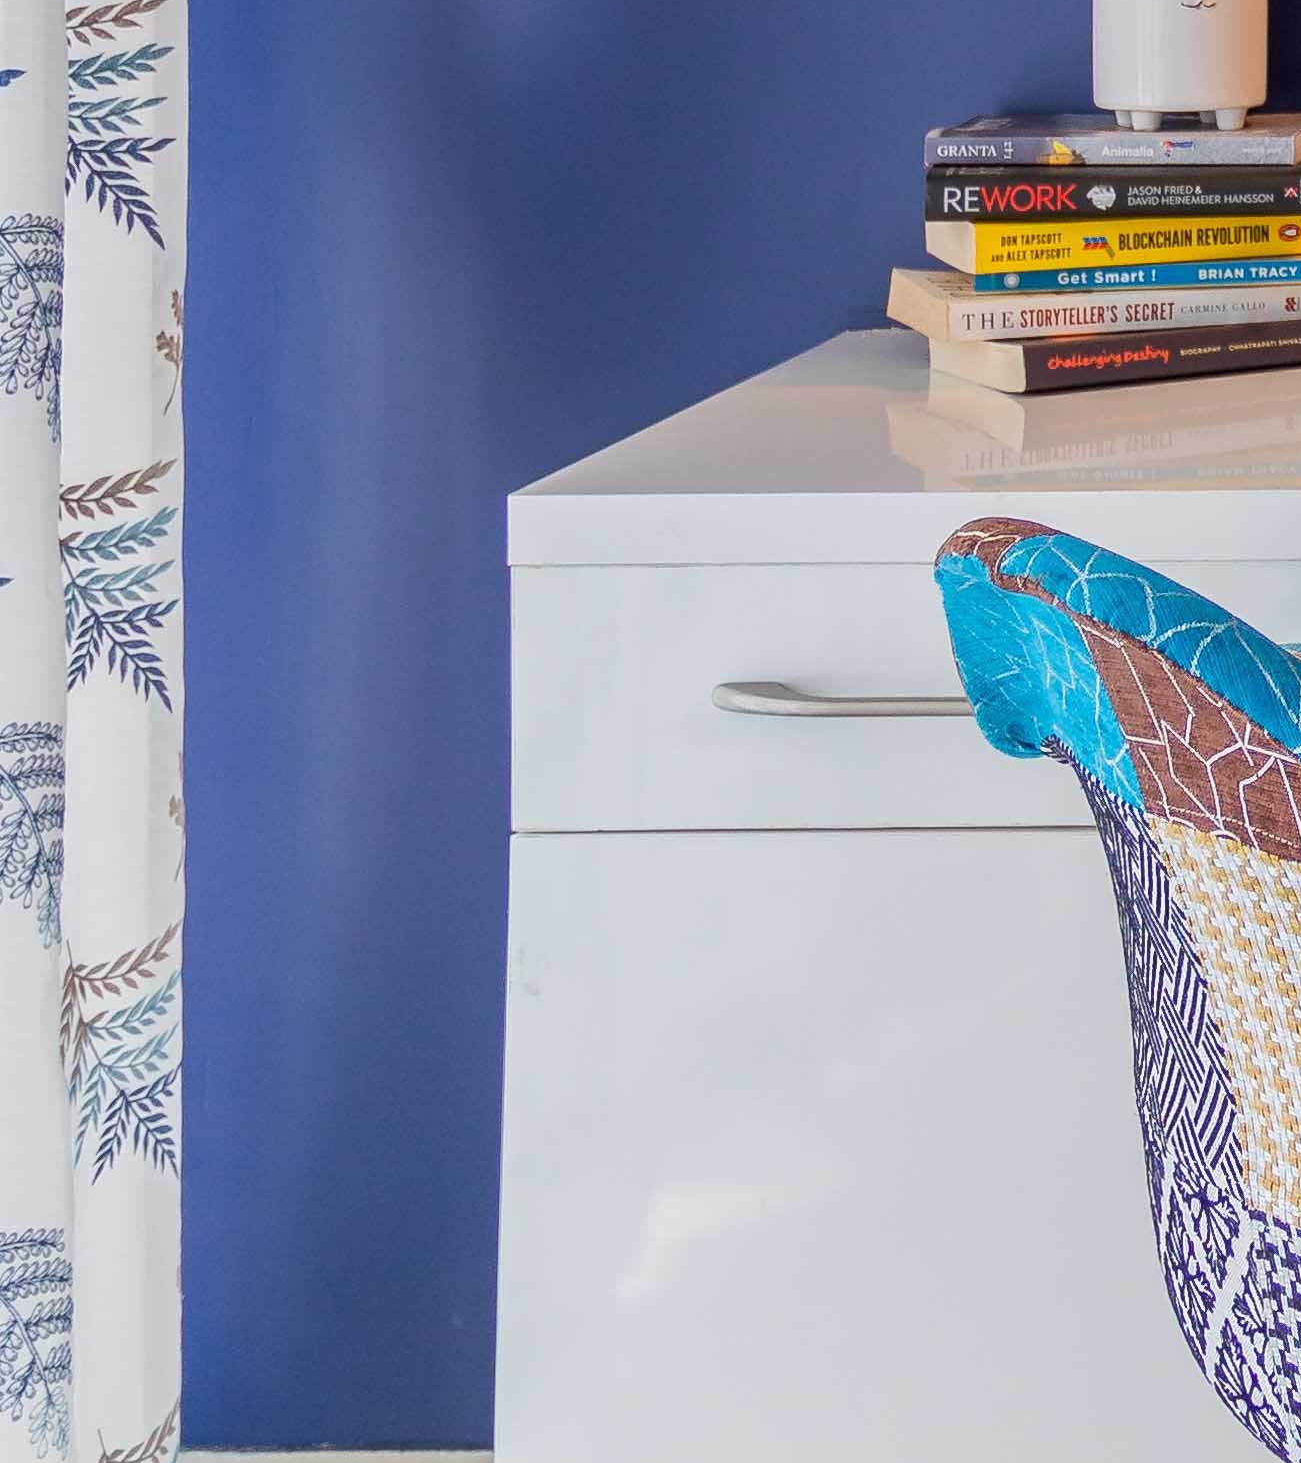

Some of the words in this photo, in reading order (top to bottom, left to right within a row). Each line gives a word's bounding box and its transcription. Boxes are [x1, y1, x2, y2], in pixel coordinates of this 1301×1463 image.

[936, 144, 998, 159] GRANTA
[1101, 144, 1155, 158] Animalia
[1127, 185, 1162, 196] JASON
[1164, 185, 1194, 195] FRIED
[1194, 185, 1202, 194] &
[943, 183, 1078, 214] REWORK
[1127, 196, 1159, 207] DAVID
[1161, 195, 1221, 206] HEINEMEIER
[1223, 193, 1275, 204] HANSSON
[1001, 235, 1018, 247] DON
[1020, 233, 1063, 246] TAPSCOTT
[1118, 231, 1193, 251] BLOCKCHAIN
[1196, 224, 1270, 247] REVOLUTION
[1006, 249, 1027, 262] ALEX
[1030, 247, 1072, 260] TAPSCOTT
[1057, 272, 1087, 286] Get
[1094, 269, 1145, 284] Smart
[1151, 269, 1157, 282] !
[1198, 268, 1244, 281] BRIAN
[1249, 266, 1298, 279] TRACY
[1180, 304, 1229, 314] CARMINE
[1231, 302, 1266, 312] GALLO
[961, 310, 1015, 332] THE
[1019, 304, 1119, 329] STORYTELLER'S
[1125, 302, 1175, 323] SECRET
[1180, 346, 1222, 357] BIOGRAPHY
